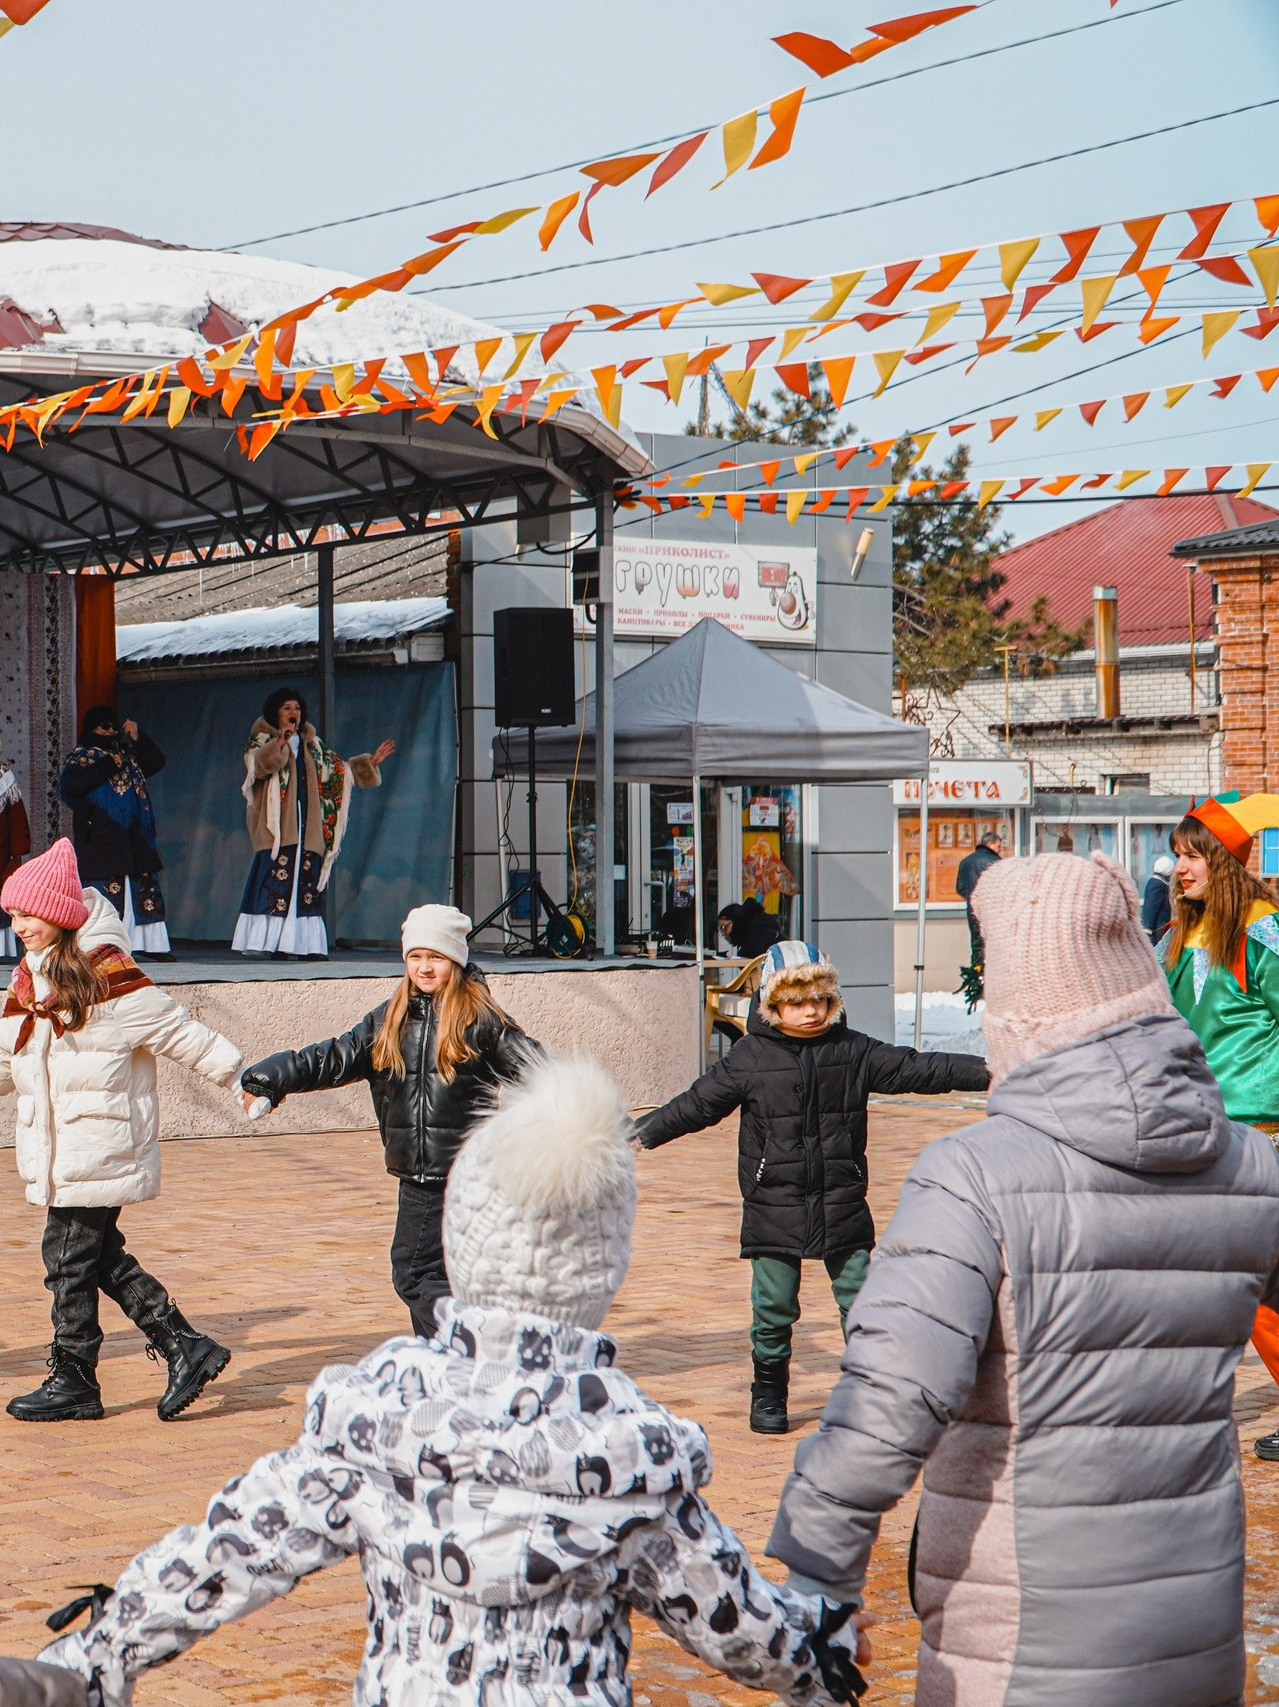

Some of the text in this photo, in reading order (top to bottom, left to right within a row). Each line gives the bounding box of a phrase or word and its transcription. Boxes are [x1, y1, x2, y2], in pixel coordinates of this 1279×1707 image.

[615, 560, 740, 608] ГРУШКИ
[653, 610, 688, 618] ПРИКОЛЫ
[740, 614, 776, 622] СУВЕНИРЫ
[617, 618, 666, 627] КАНЦТОВАРЫ
